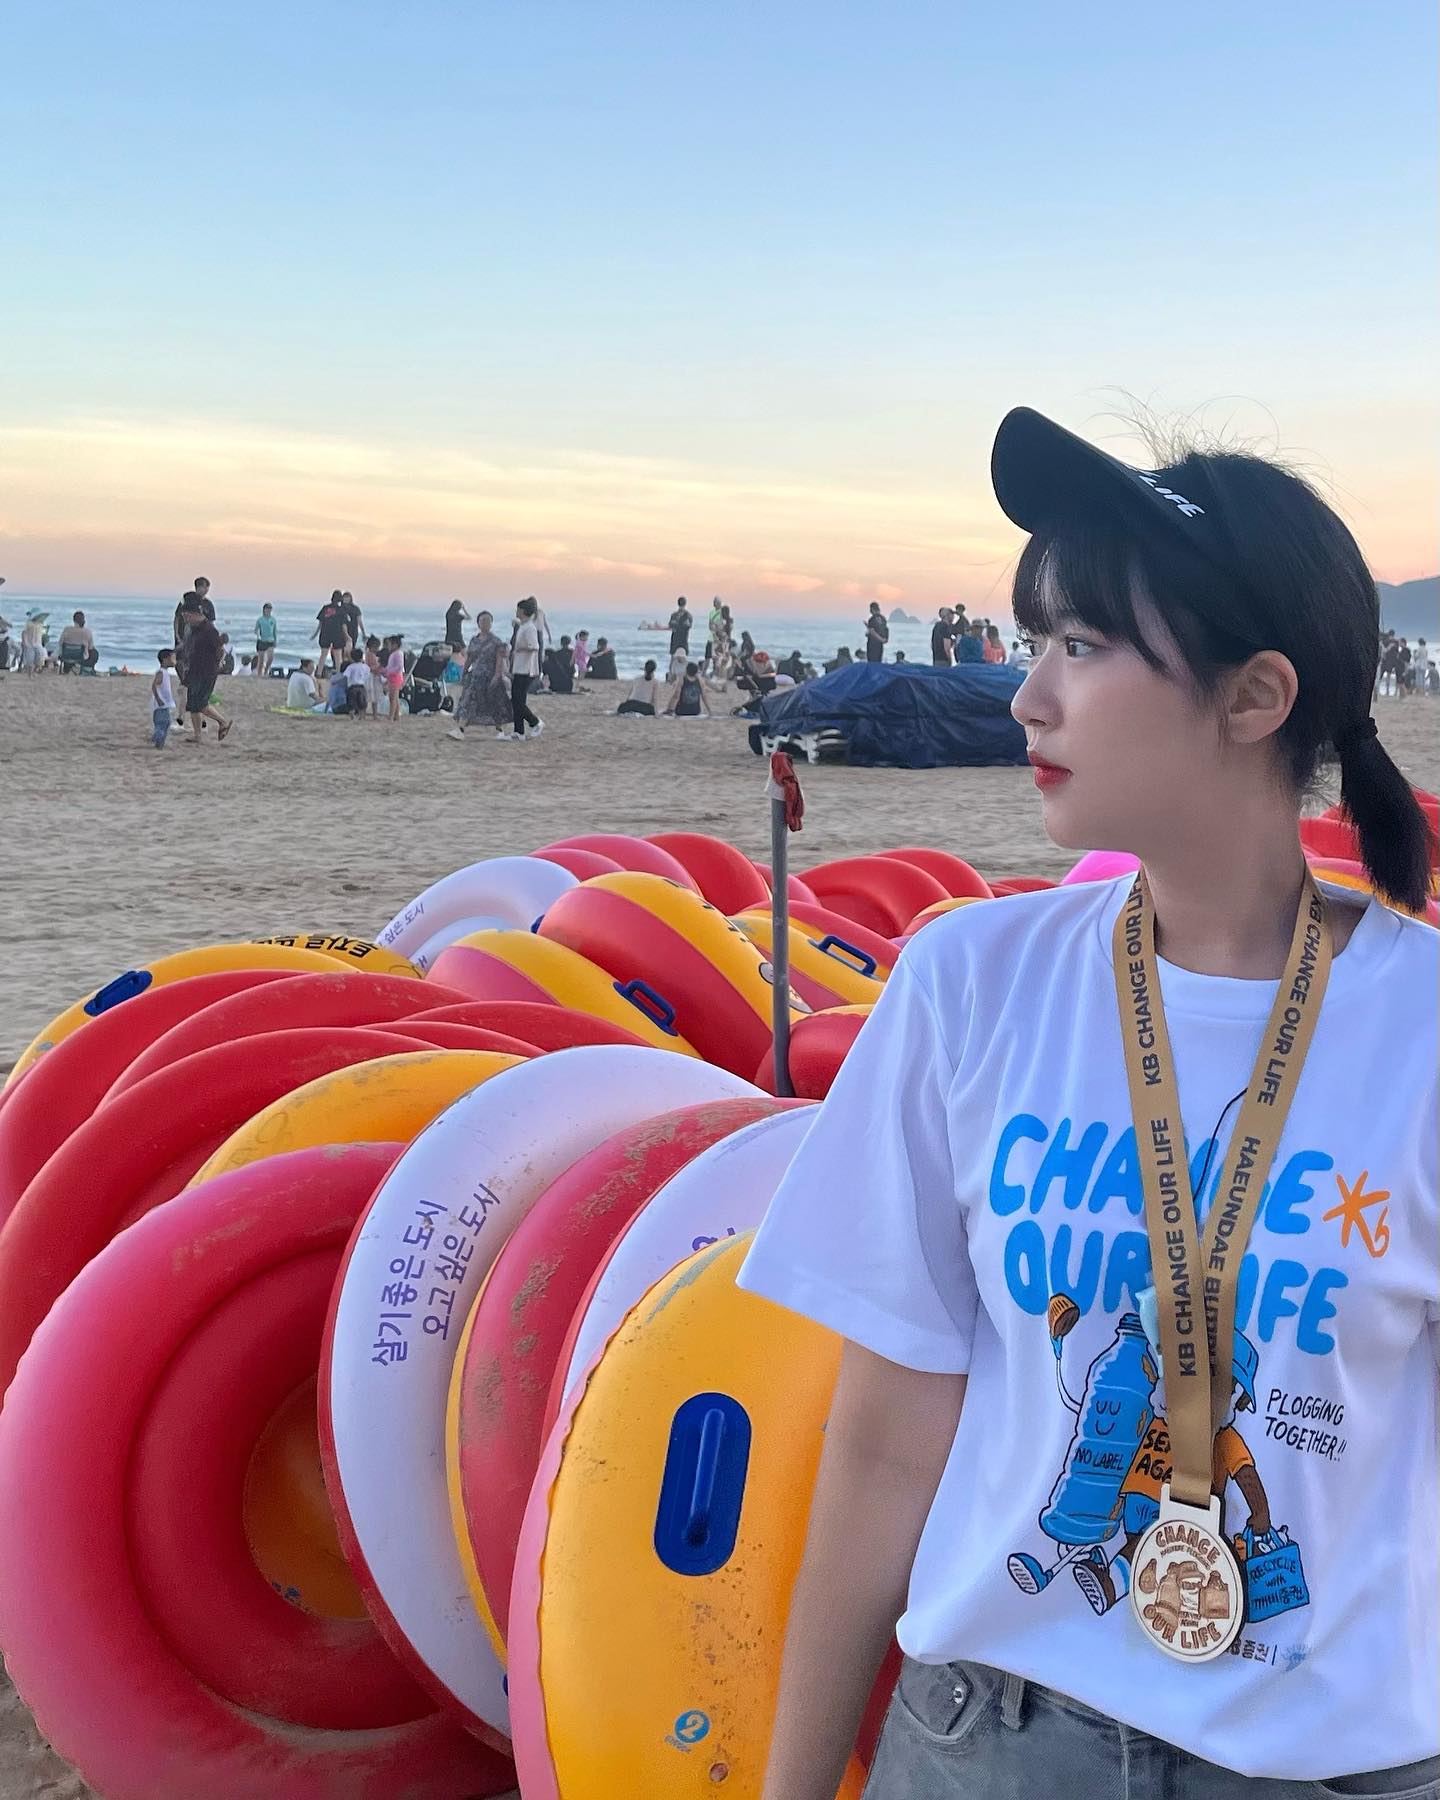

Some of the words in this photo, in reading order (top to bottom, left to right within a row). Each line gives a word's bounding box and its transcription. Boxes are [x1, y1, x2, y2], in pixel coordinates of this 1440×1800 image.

[1126, 913, 1144, 957] OUR
[1290, 924, 1321, 1004] CHANGE
[1129, 959, 1155, 1049] CHANGE
[1274, 1008, 1301, 1056] OUR
[1142, 1053, 1162, 1086] KB
[1257, 1058, 1286, 1106] LIFE
[1151, 1118, 1174, 1166] LIFE
[458, 1183, 501, 1236] 도시
[1159, 1171, 1181, 1224] OUR
[1208, 1136, 1262, 1272] HAEUNDAE
[1166, 1229, 1193, 1335] CHANGE
[1178, 1343, 1198, 1377] KB
[1266, 1388, 1344, 1426] PLOGGING
[1073, 1447, 1092, 1464] NO
[1265, 1415, 1348, 1462] TOGETHER!!
[1156, 1525, 1220, 1564] CHANGE
[1250, 1557, 1297, 1582] RECYCLE
[1265, 1573, 1287, 1588] with
[1143, 1604, 1174, 1643] OUR
[1180, 1622, 1221, 1649] LIFE
